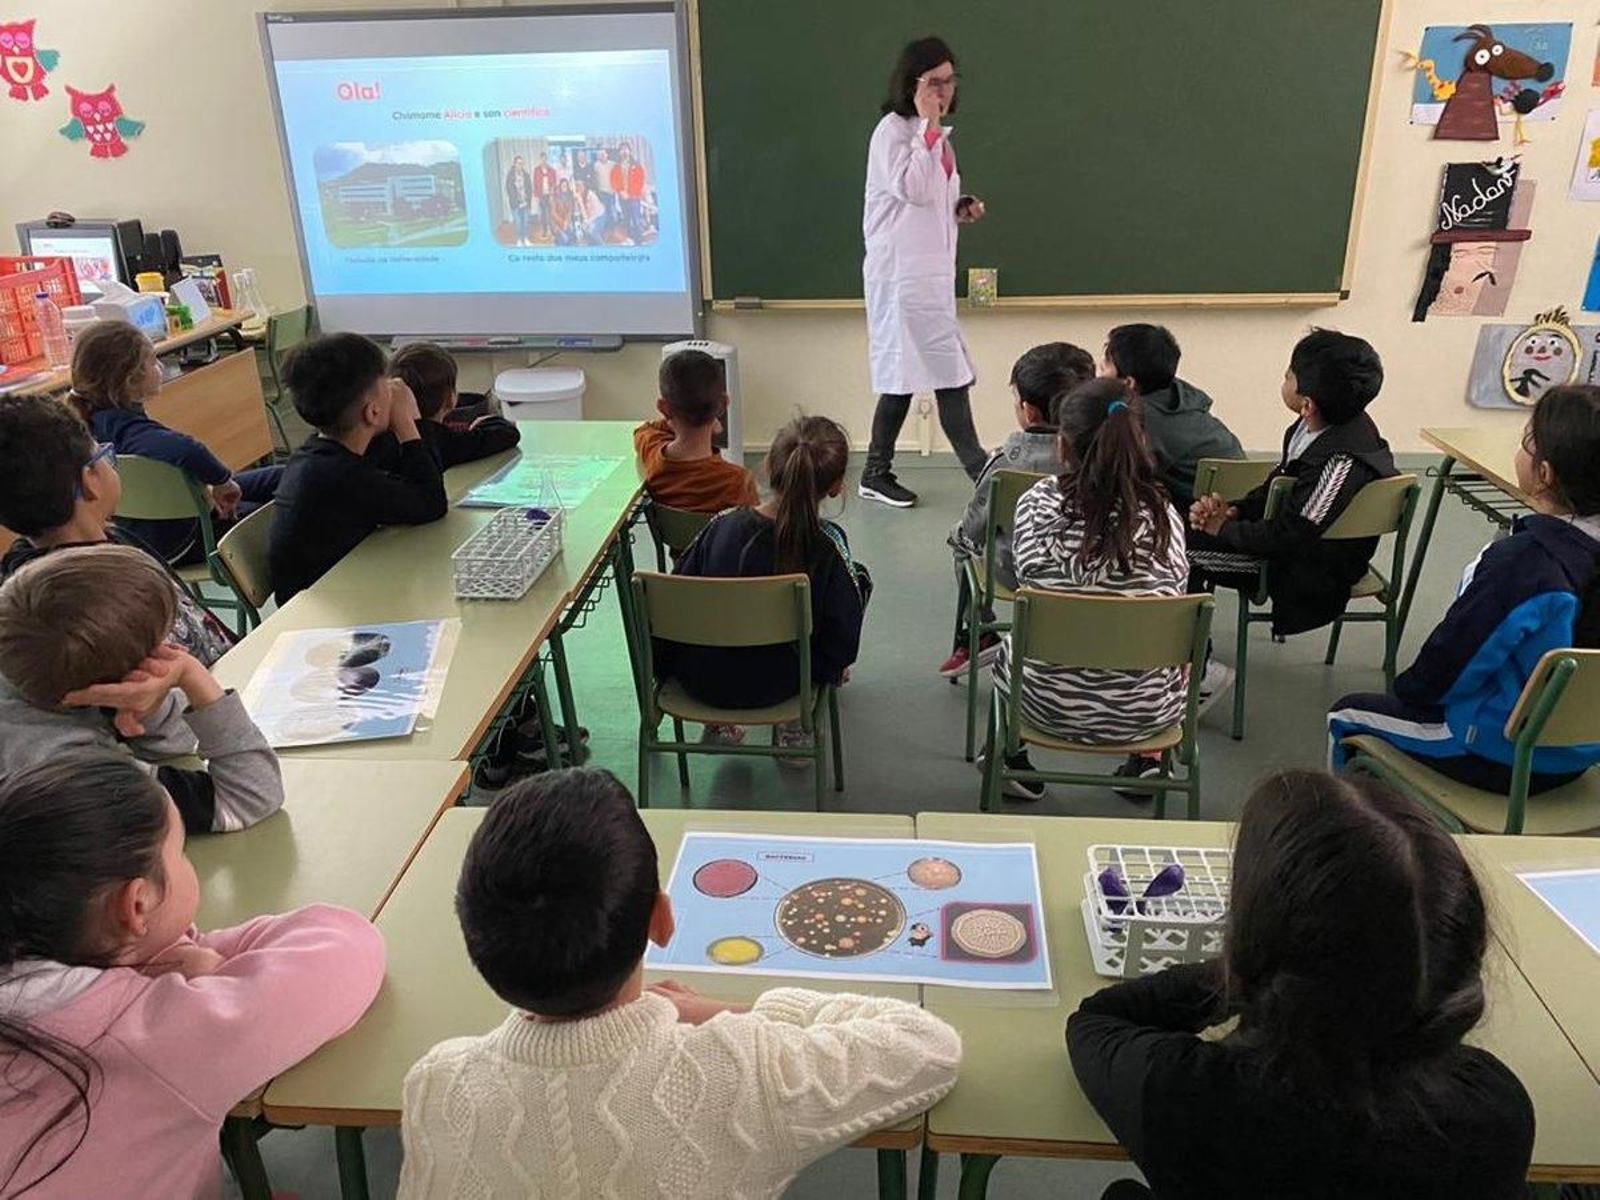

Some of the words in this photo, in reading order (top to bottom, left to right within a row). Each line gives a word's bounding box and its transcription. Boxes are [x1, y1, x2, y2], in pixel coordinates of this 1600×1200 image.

[337, 81, 380, 101] Ola!
[443, 107, 472, 120] Alicia
[483, 109, 502, 119] son
